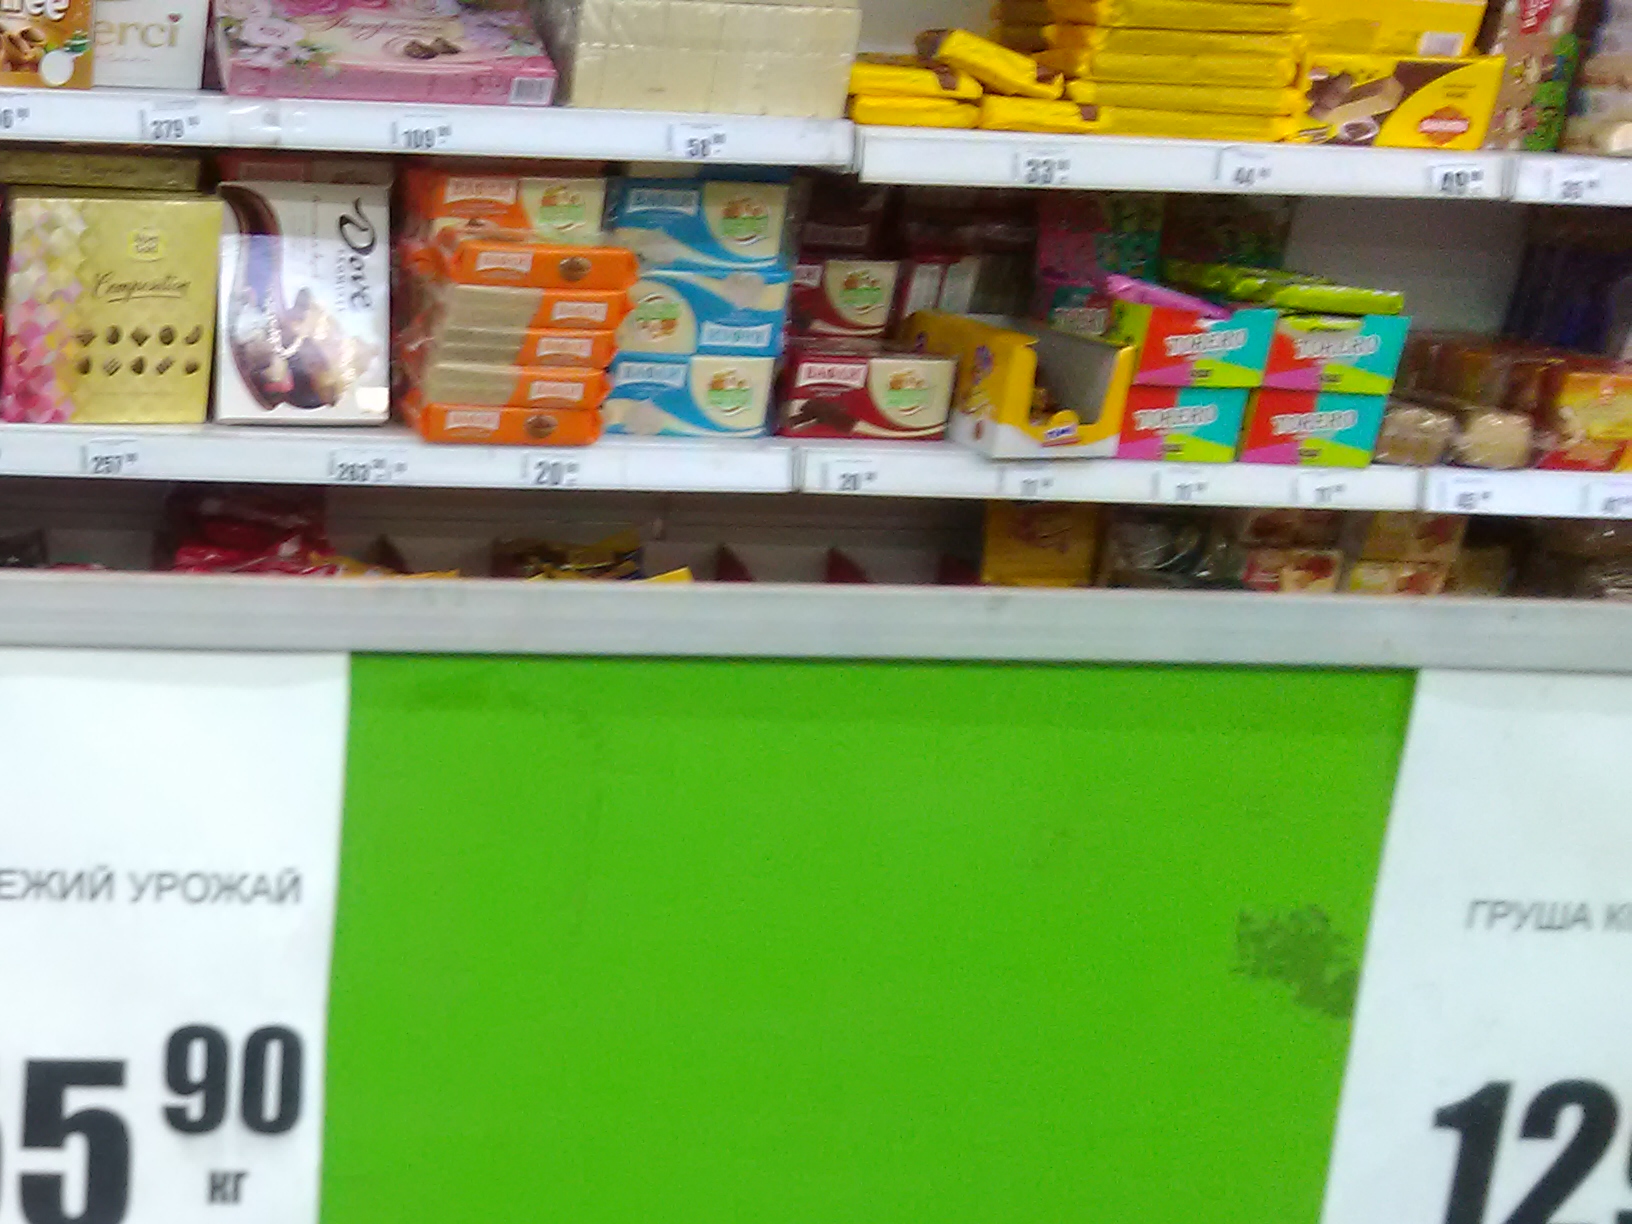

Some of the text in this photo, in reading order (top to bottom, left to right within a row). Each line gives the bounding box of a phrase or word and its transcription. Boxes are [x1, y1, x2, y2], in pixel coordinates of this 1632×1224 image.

[95, 13, 182, 47] erci
[150, 118, 185, 140] 379
[338, 197, 378, 312] Dove
[128, 866, 303, 905] УРОЖАЙ
[1465, 898, 1593, 933] ГРУША
[161, 1022, 305, 1137] 90
